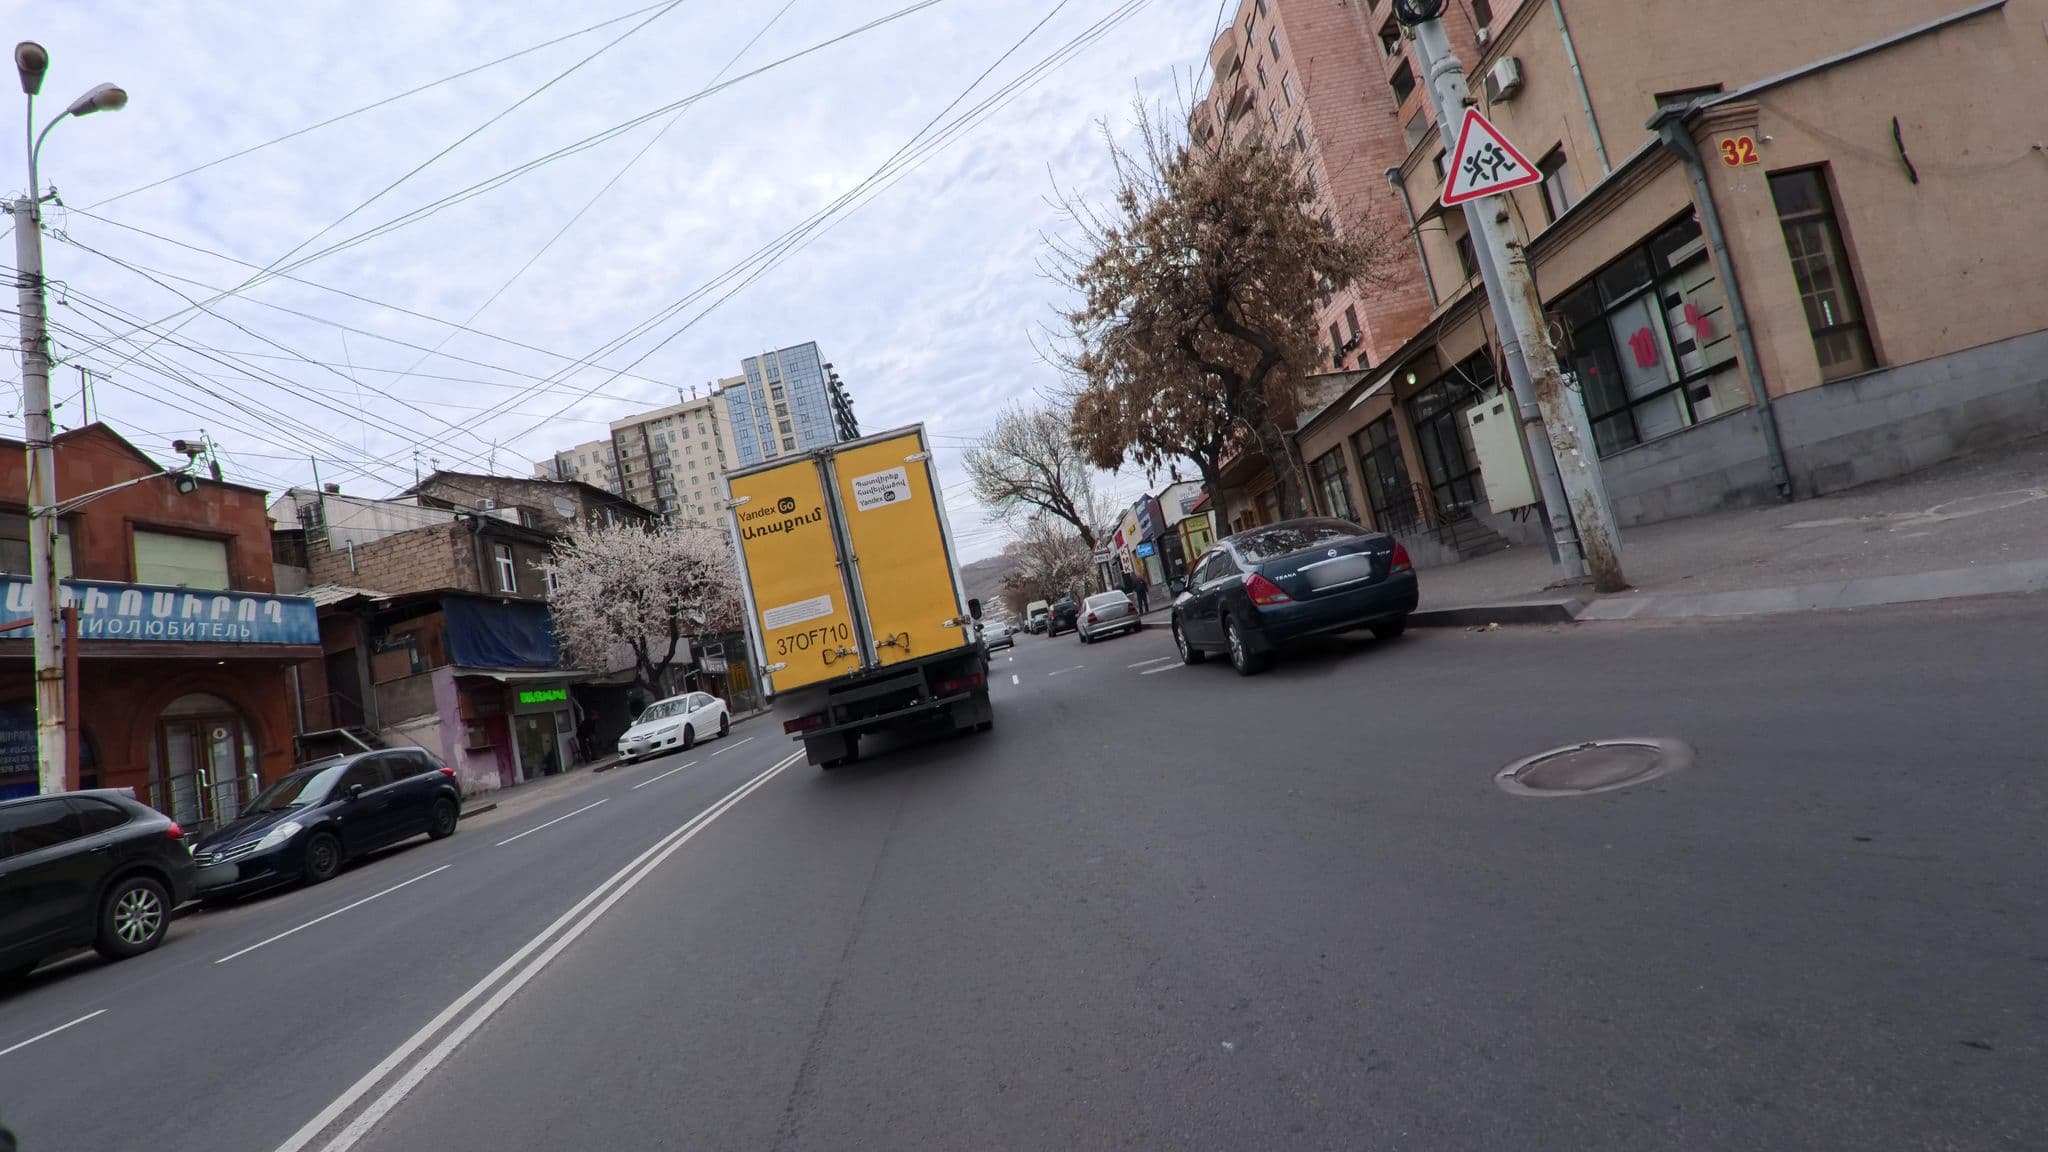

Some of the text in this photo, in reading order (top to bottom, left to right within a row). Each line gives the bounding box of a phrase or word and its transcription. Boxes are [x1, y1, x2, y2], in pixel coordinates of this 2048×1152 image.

[1721, 136, 1759, 166] 32
[739, 499, 795, 522] Yandex Go
[859, 492, 895, 506] Yandex Go
[742, 507, 822, 540] Առաքում
[1275, 572, 1297, 581] TEANA
[78, 618, 250, 638] ИОЛЮБИТЕЛЬ
[777, 622, 848, 656] 37OF710
